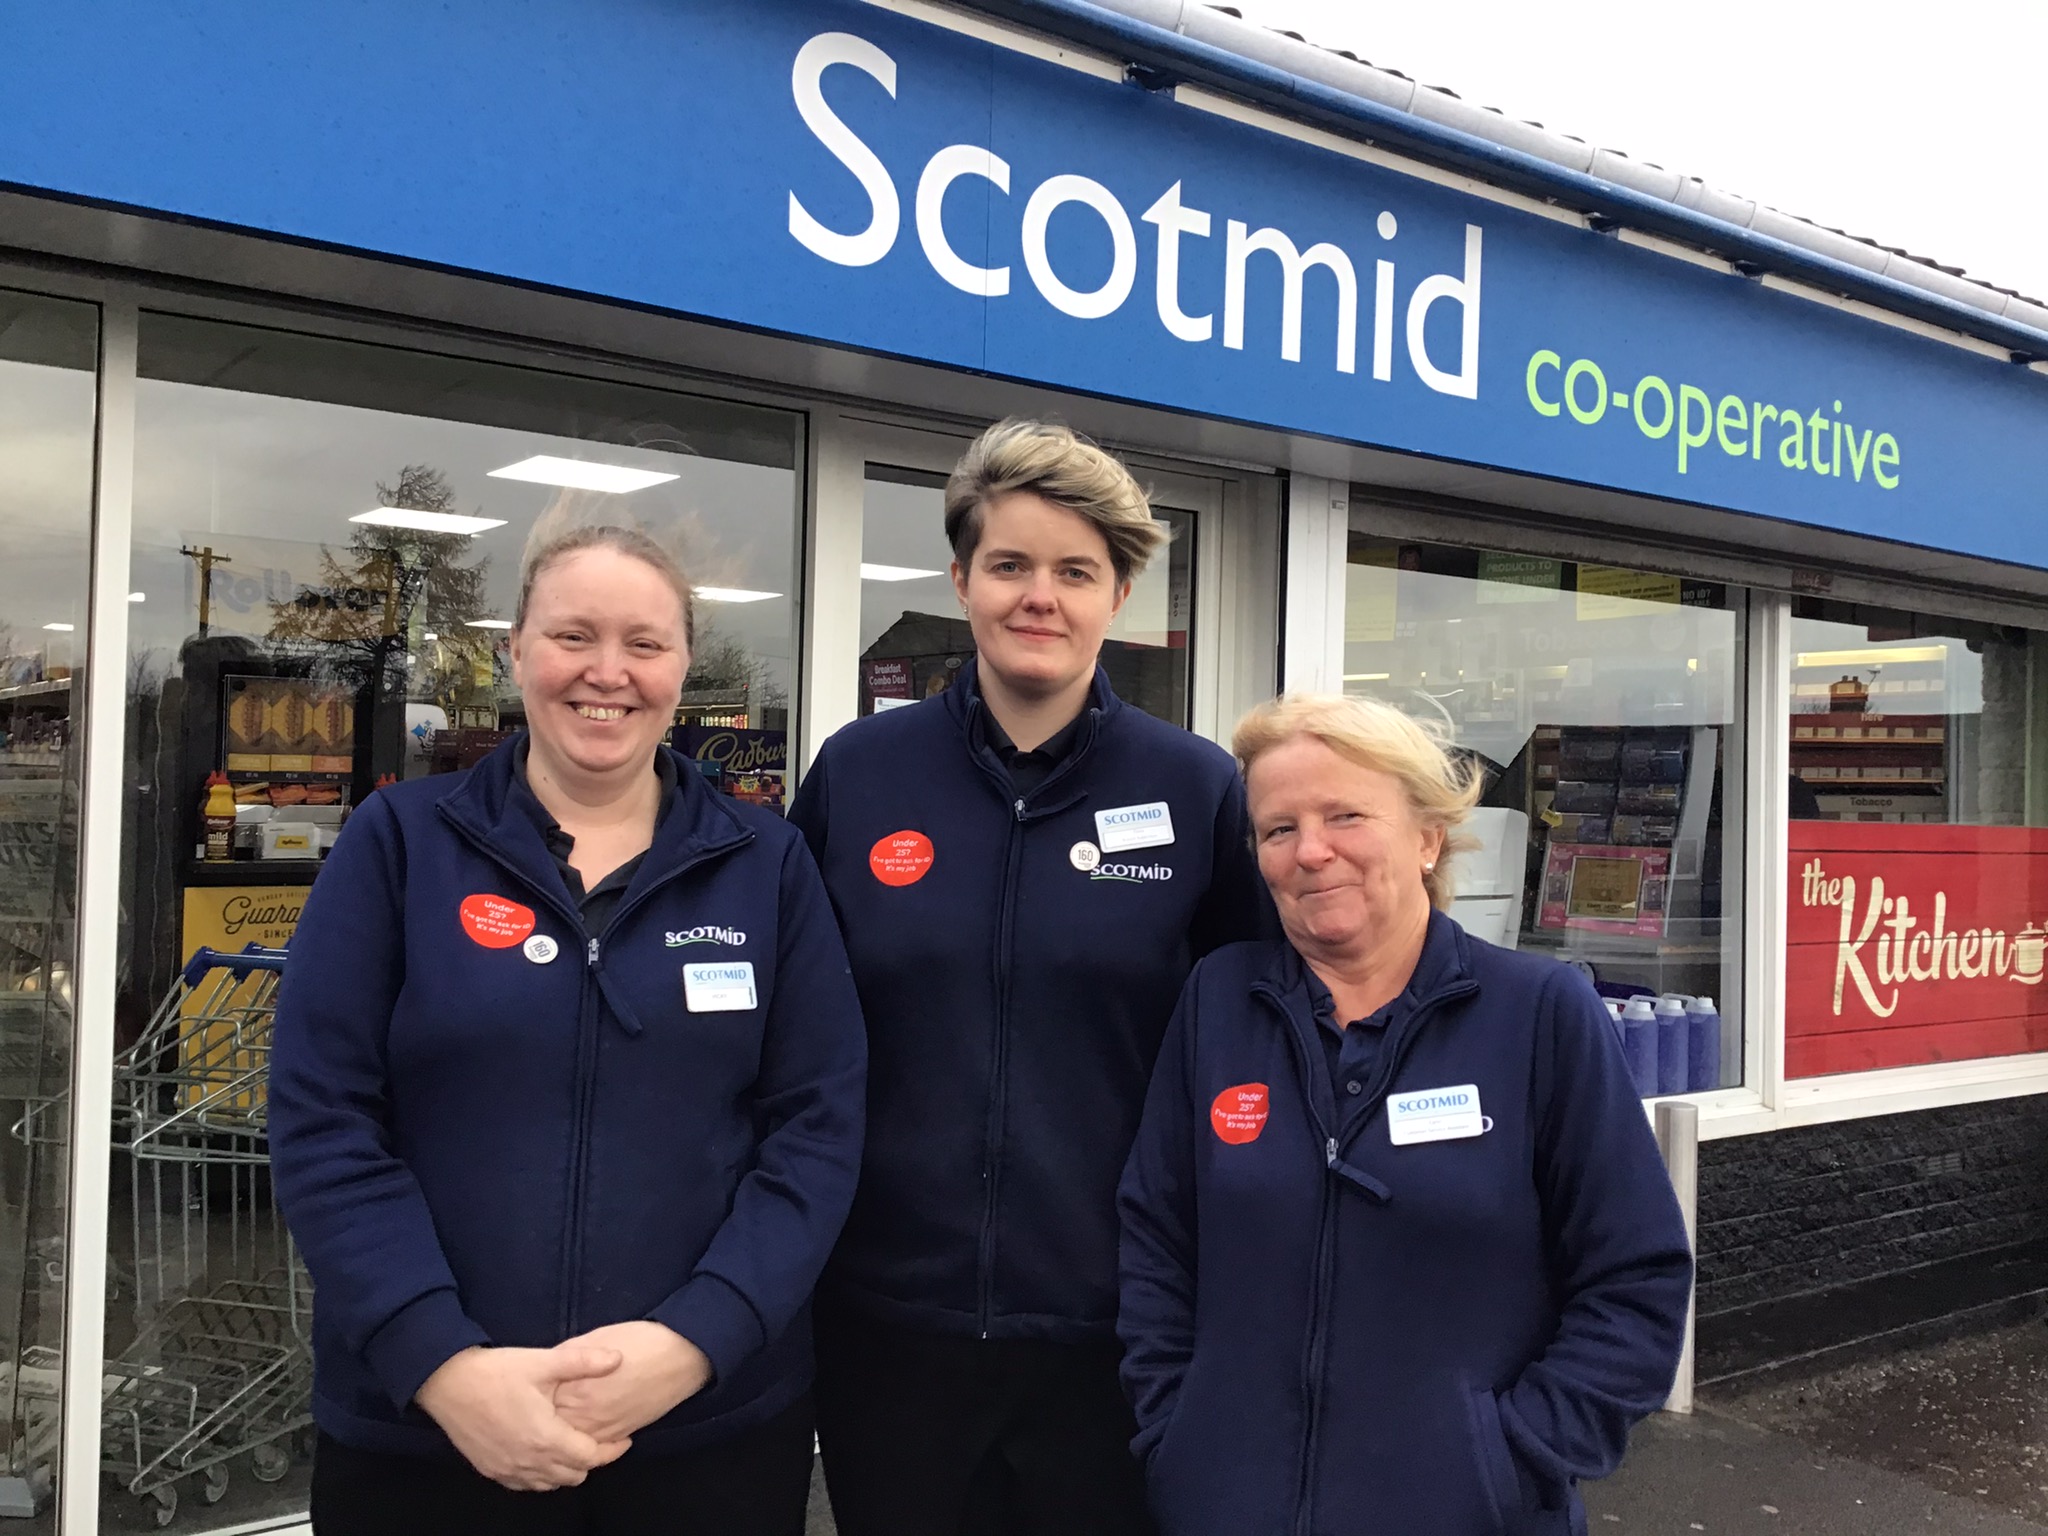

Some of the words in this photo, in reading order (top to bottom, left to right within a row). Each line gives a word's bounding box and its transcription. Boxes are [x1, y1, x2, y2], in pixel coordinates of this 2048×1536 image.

[789, 32, 1482, 400] Scotmid
[1526, 349, 1899, 489] co-operative
[1486, 561, 1536, 572] PRODUCTS
[1538, 560, 1553, 571] TO
[1522, 574, 1556, 584] UNDER
[874, 664, 902, 675] Breakfast
[869, 676, 892, 686] Combo
[892, 674, 907, 685] Deal
[696, 732, 786, 771] Cadbur
[1849, 797, 1893, 807] Tobacco
[208, 832, 229, 841] mild
[892, 839, 919, 848] Under
[895, 848, 911, 857] 25?
[1078, 849, 1094, 862] 160
[1801, 858, 1843, 906] the
[484, 900, 516, 914] Under
[223, 896, 302, 935] Guara
[488, 910, 507, 920] 25?
[532, 940, 552, 958] 160
[1833, 875, 2012, 1018] Kitchen
[1237, 1092, 1263, 1102] Under
[1238, 1103, 1255, 1112] 25?
